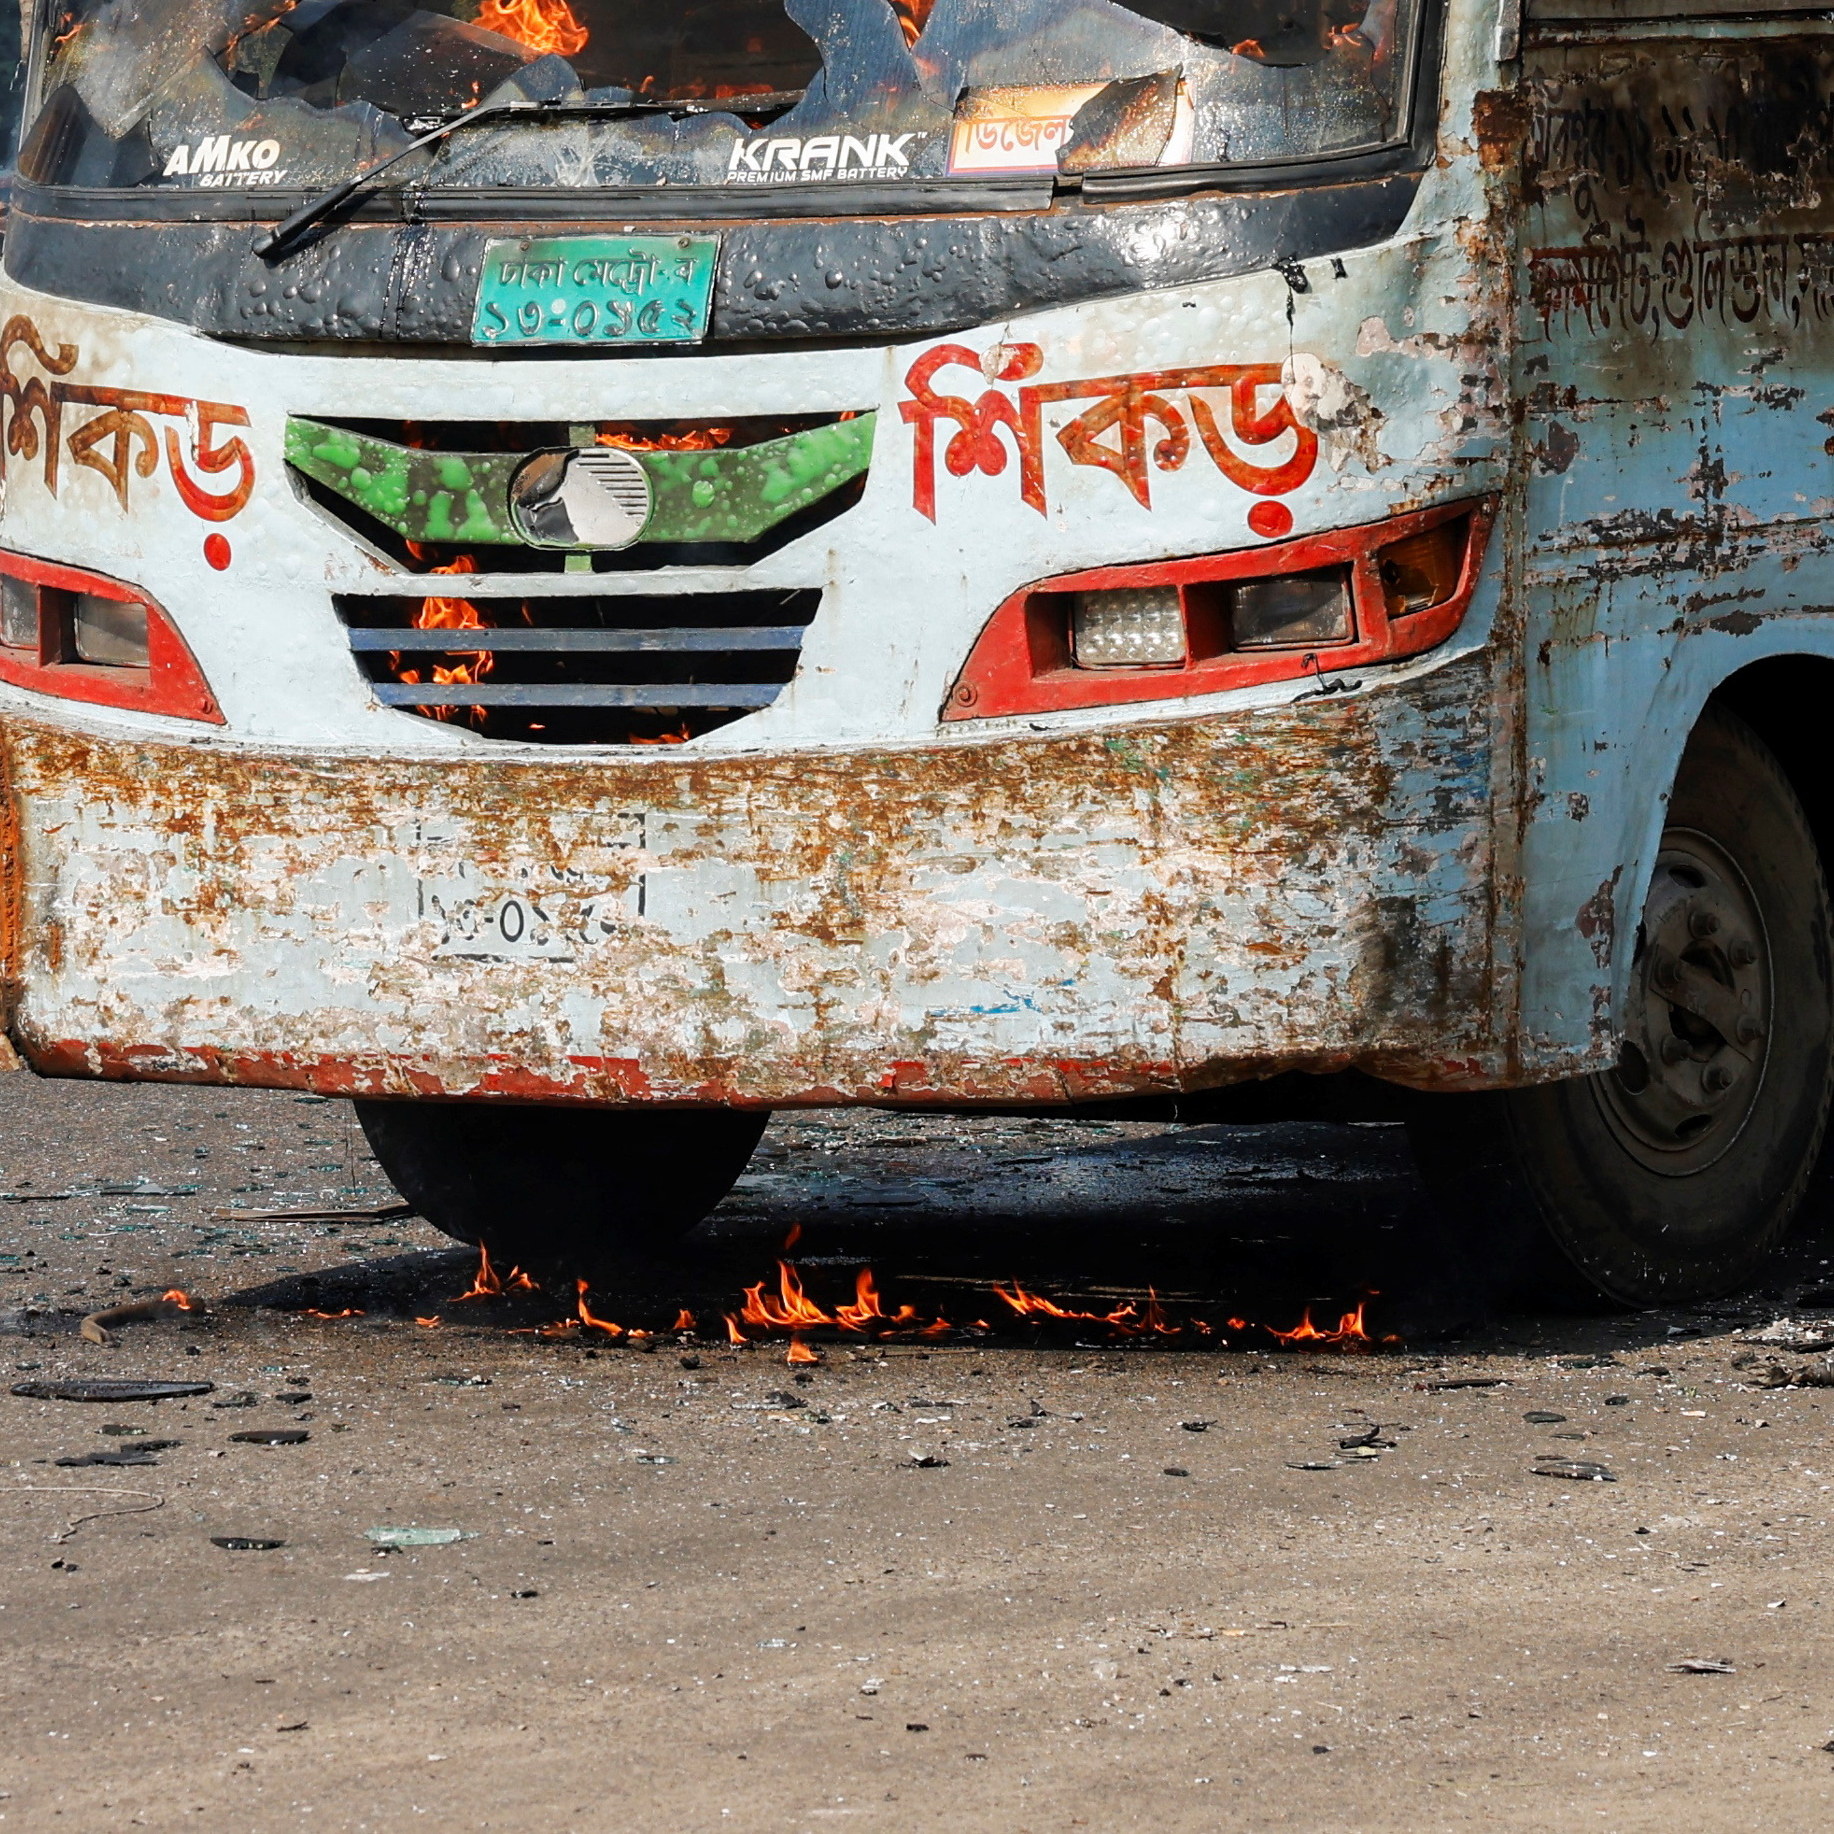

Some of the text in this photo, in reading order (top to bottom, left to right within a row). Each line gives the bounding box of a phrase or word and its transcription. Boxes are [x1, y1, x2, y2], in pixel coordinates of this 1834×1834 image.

[162, 134, 281, 177] AMKO
[199, 169, 289, 188] BATTERY
[727, 166, 909, 184] PREMIUM SMF BATTERY
[499, 255, 569, 289] ঢাকা
[896, 342, 1320, 539] শিকড়
